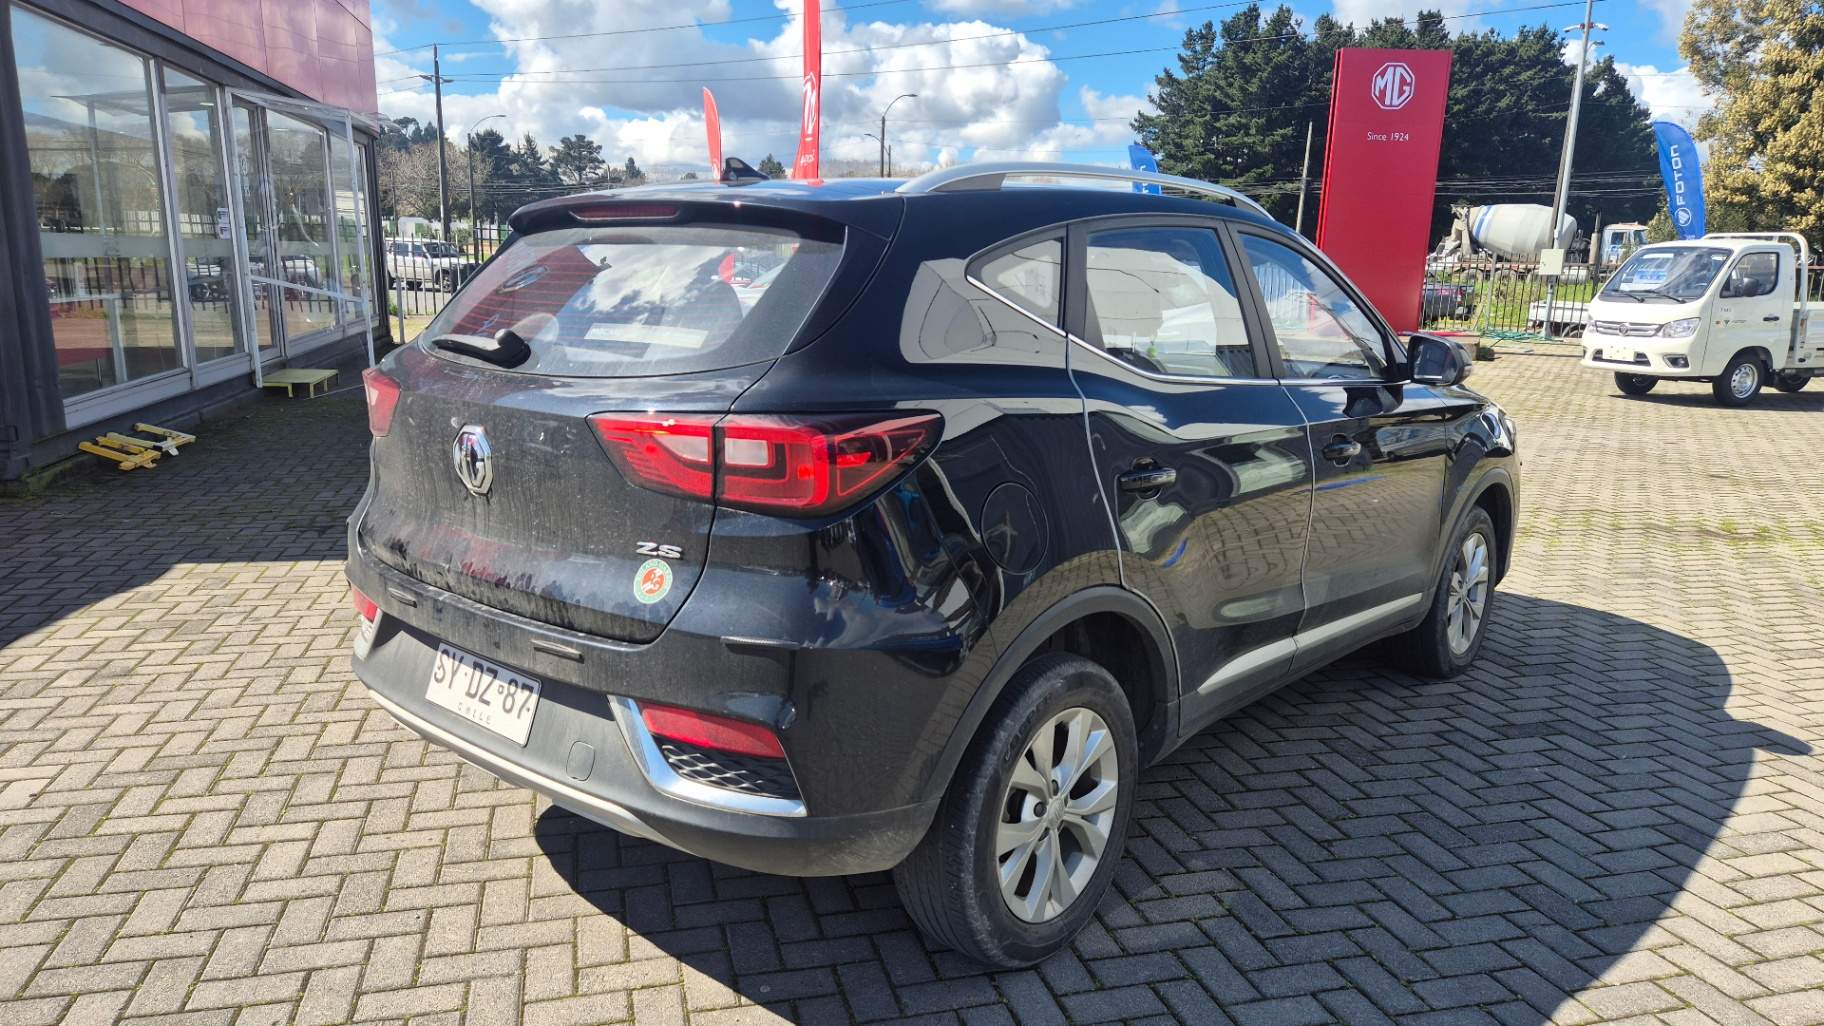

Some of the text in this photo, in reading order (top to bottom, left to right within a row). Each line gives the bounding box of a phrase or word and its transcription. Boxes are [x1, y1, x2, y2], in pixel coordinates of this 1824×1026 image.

[1374, 65, 1412, 107] MG
[1367, 131, 1409, 142] Since 1924
[1670, 144, 1687, 206] FOTON
[636, 541, 682, 559] ZS
[457, 702, 491, 725] CILE
